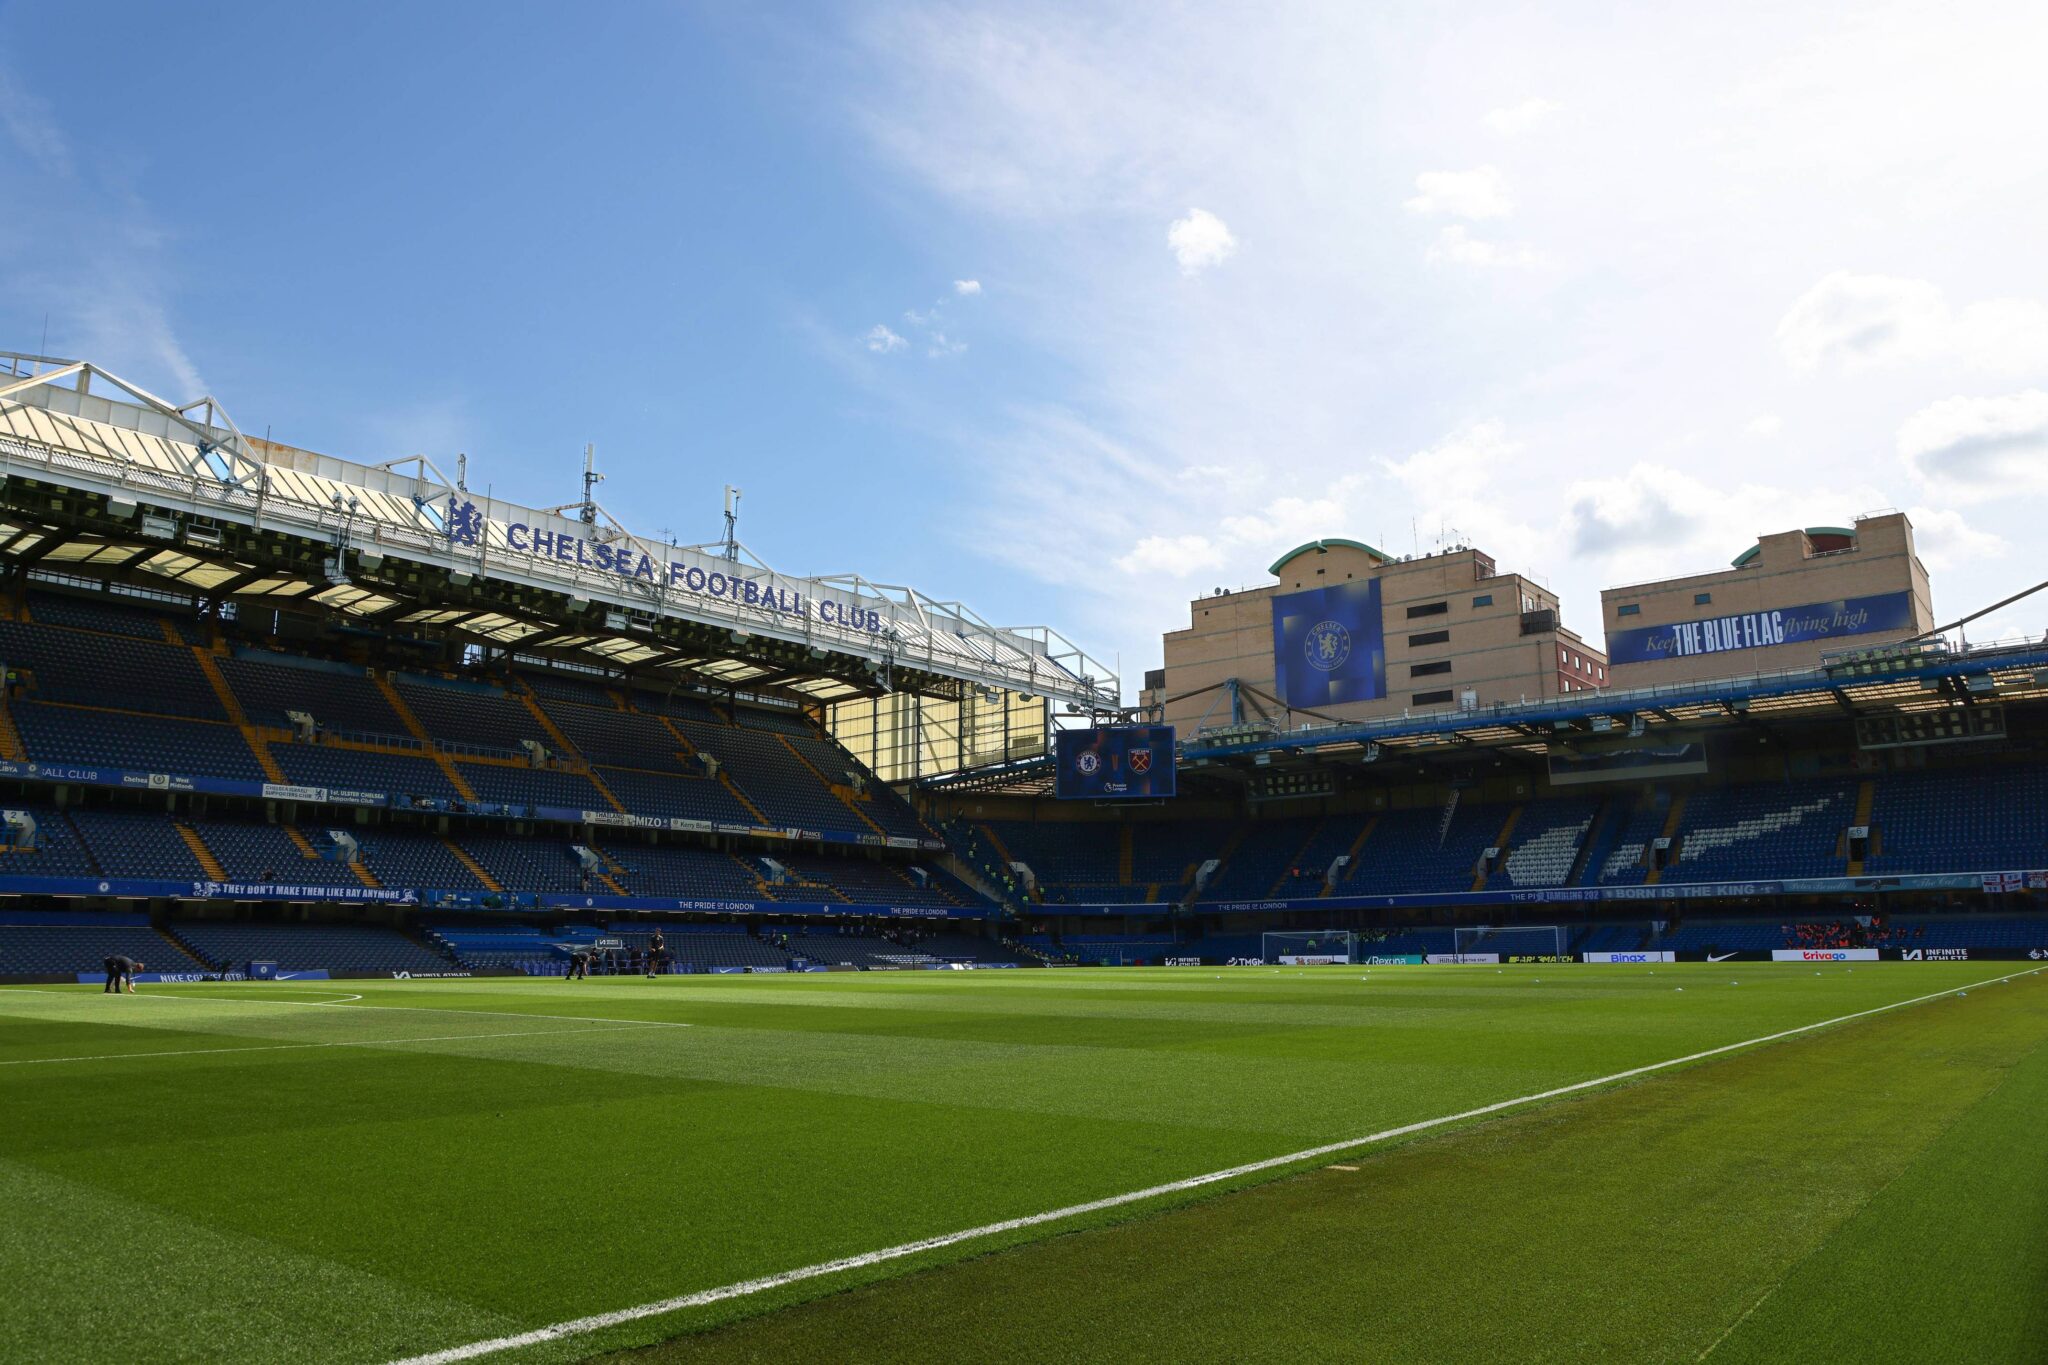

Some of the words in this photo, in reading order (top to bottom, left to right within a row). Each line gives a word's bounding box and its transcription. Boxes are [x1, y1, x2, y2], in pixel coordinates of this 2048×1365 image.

[507, 522, 654, 580] CHELSEA
[670, 561, 806, 616] FOOTBALL
[820, 600, 880, 632] CLUB
[1312, 623, 1341, 635] CHELSEA
[1646, 633, 1678, 653] Keep
[1672, 622, 1702, 656] THE
[1703, 616, 1742, 653] BLUE
[1742, 611, 1784, 648] FLAG
[1783, 615, 1828, 636] flying
[1832, 608, 1868, 630] high
[68, 770, 97, 780] CLUB
[123, 776, 148, 784] Chelsea
[635, 816, 662, 827] MIZO
[680, 821, 695, 829] Kerry
[223, 884, 246, 894] THEY
[247, 885, 274, 895] DON'T
[276, 886, 299, 895] MAKE
[302, 887, 324, 896] THEM
[326, 887, 344, 897] LIKE
[345, 888, 361, 898] RAY
[362, 889, 400, 899] ANYMORE
[1616, 888, 1656, 899] BORN
[1662, 887, 1674, 897] IS
[1681, 885, 1712, 897] THE
[1717, 883, 1754, 896] KING
[679, 901, 693, 909] THE
[694, 902, 716, 910] PRIDE
[725, 902, 755, 911] LONDON
[1231, 903, 1251, 911] PRIDE
[1259, 902, 1288, 910] LONDON
[925, 908, 948, 916] LONDON
[1238, 957, 1264, 966] TMGM
[1372, 956, 1407, 965] Rexona
[1803, 952, 1846, 961] trivago
